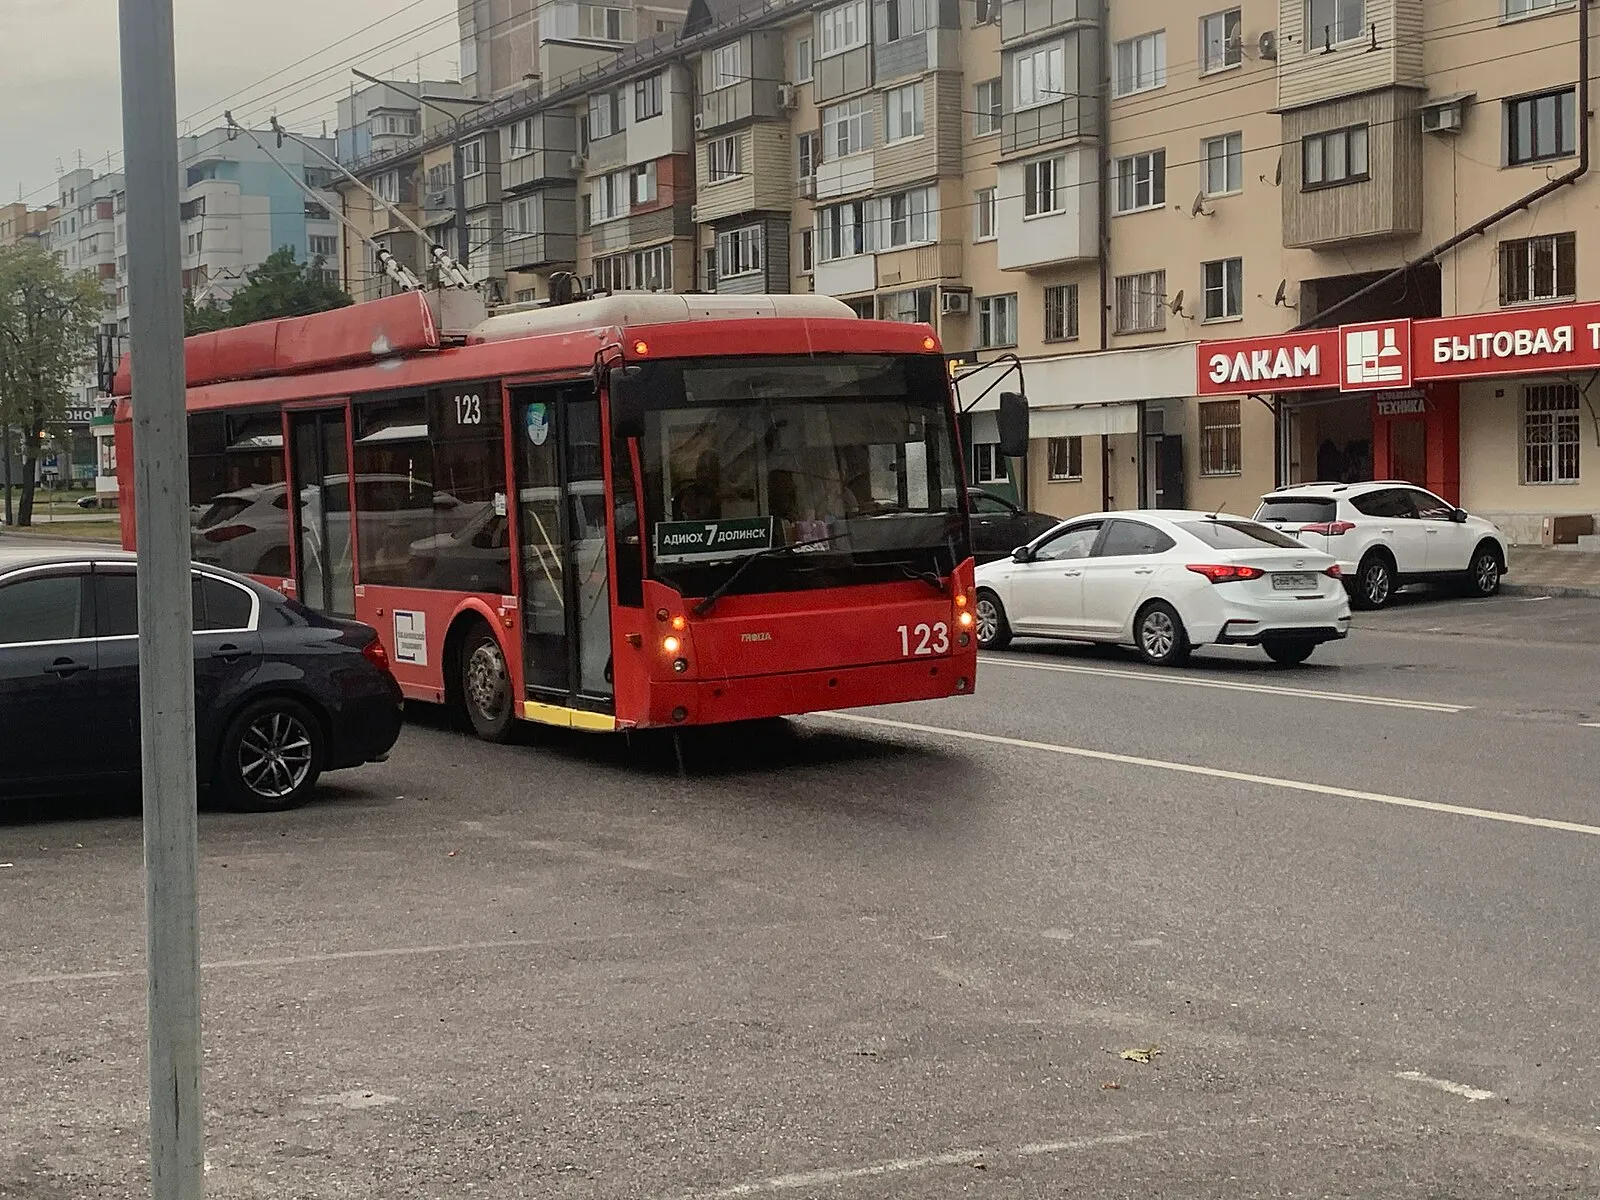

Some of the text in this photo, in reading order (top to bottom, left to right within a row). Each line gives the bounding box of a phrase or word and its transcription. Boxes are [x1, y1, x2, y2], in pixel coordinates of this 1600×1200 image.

[1434, 325, 1575, 363] БЫТОВАЯ
[1209, 344, 1320, 384] ЭЛКАМ
[454, 394, 481, 424] 123
[1377, 399, 1426, 415] ТЕХНИКА
[663, 524, 766, 546] АДИЮХ 7 ДОЛИНСК
[896, 621, 950, 657] 123
